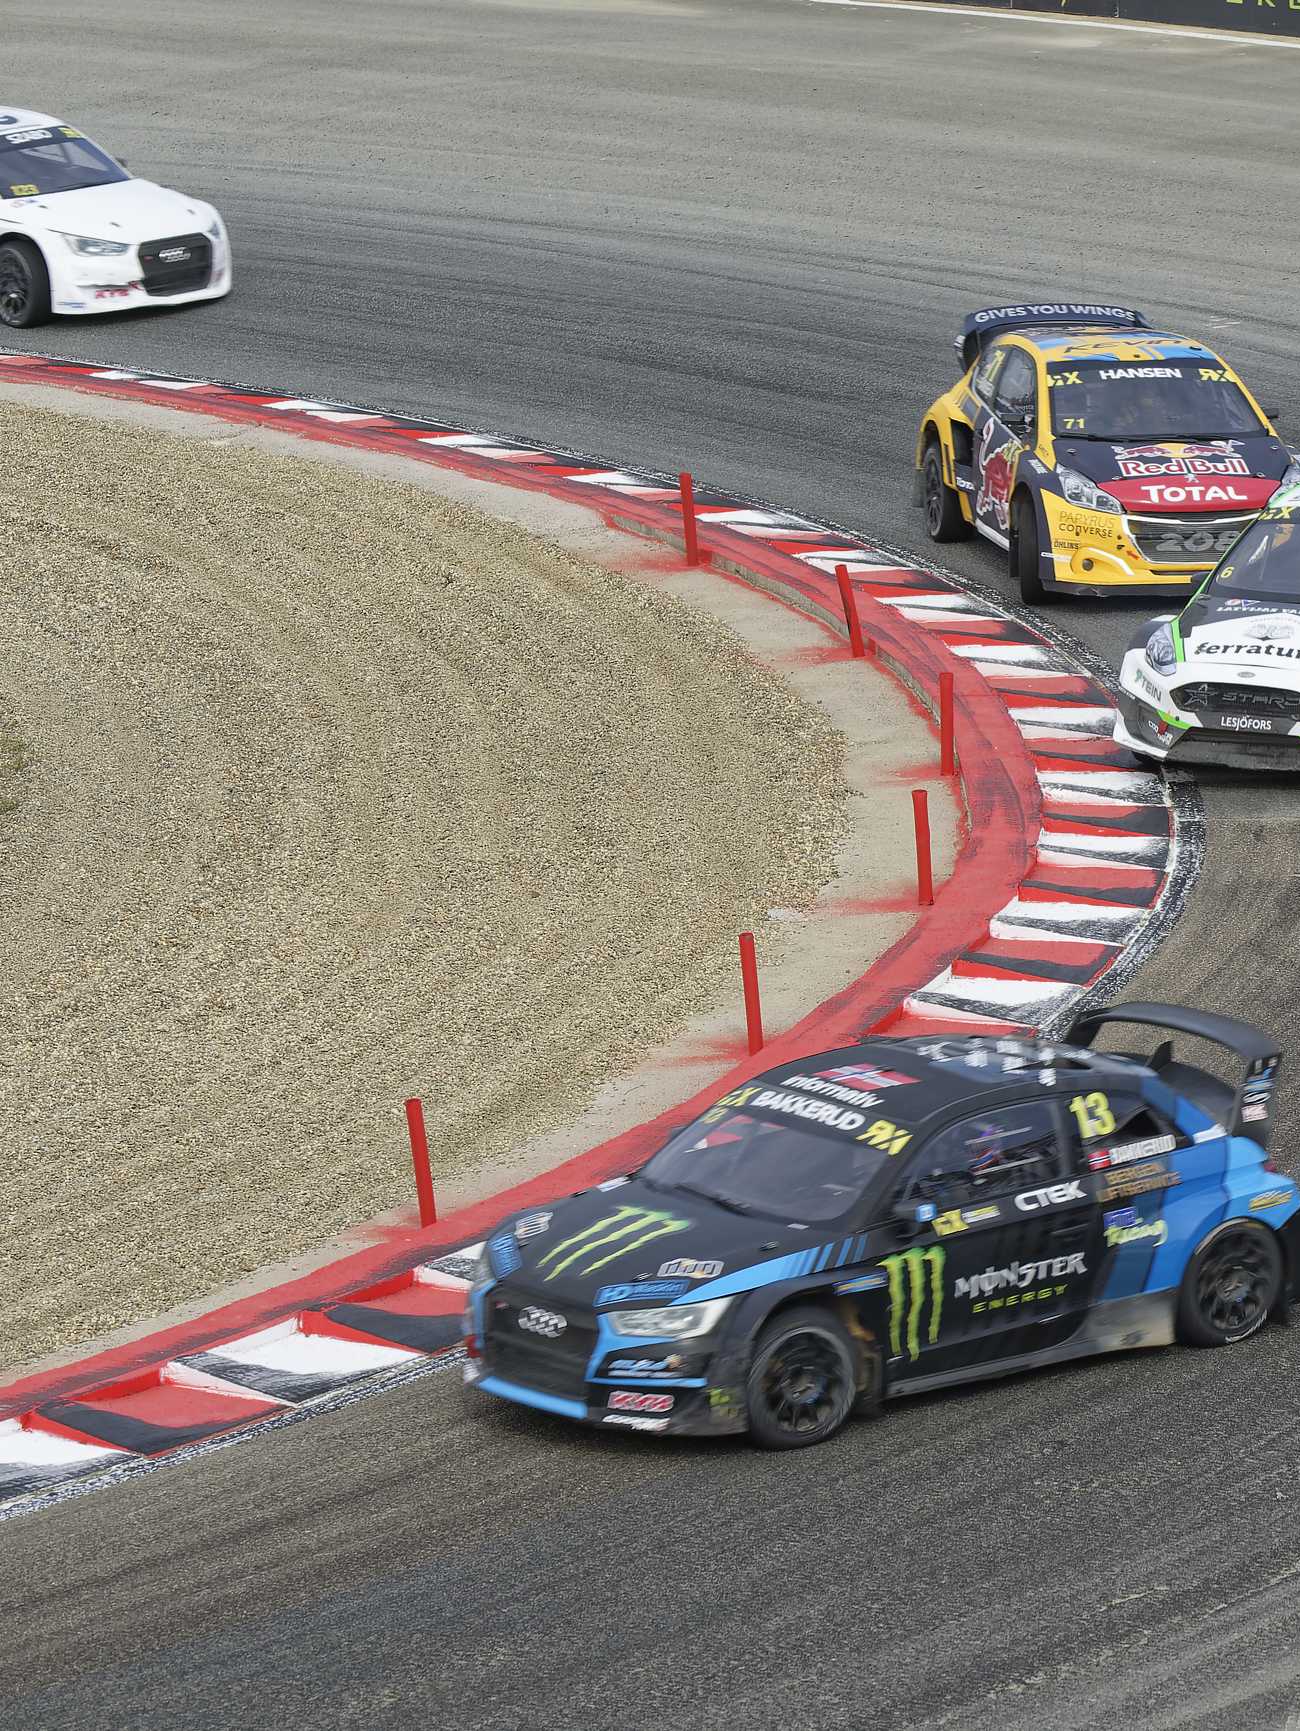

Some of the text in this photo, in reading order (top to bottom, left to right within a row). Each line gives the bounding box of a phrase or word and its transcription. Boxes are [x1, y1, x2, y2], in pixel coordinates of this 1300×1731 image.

[974, 304, 1136, 323] GIVES YOU WINGS
[1099, 367, 1183, 381] HANSEN
[1063, 417, 1085, 430] 71
[1119, 458, 1250, 477] Red Bull
[1141, 484, 1248, 503] TOTAL
[1220, 566, 1235, 579] 6
[1141, 676, 1162, 701] TEIN
[1220, 714, 1272, 731] LESJÖFORS
[750, 1090, 867, 1131] BAKKERUD
[1069, 1091, 1117, 1139] 13
[1014, 1179, 1088, 1212] CTEK
[954, 1251, 1088, 1300] MONSTER
[972, 1283, 1069, 1314] ENERGY
